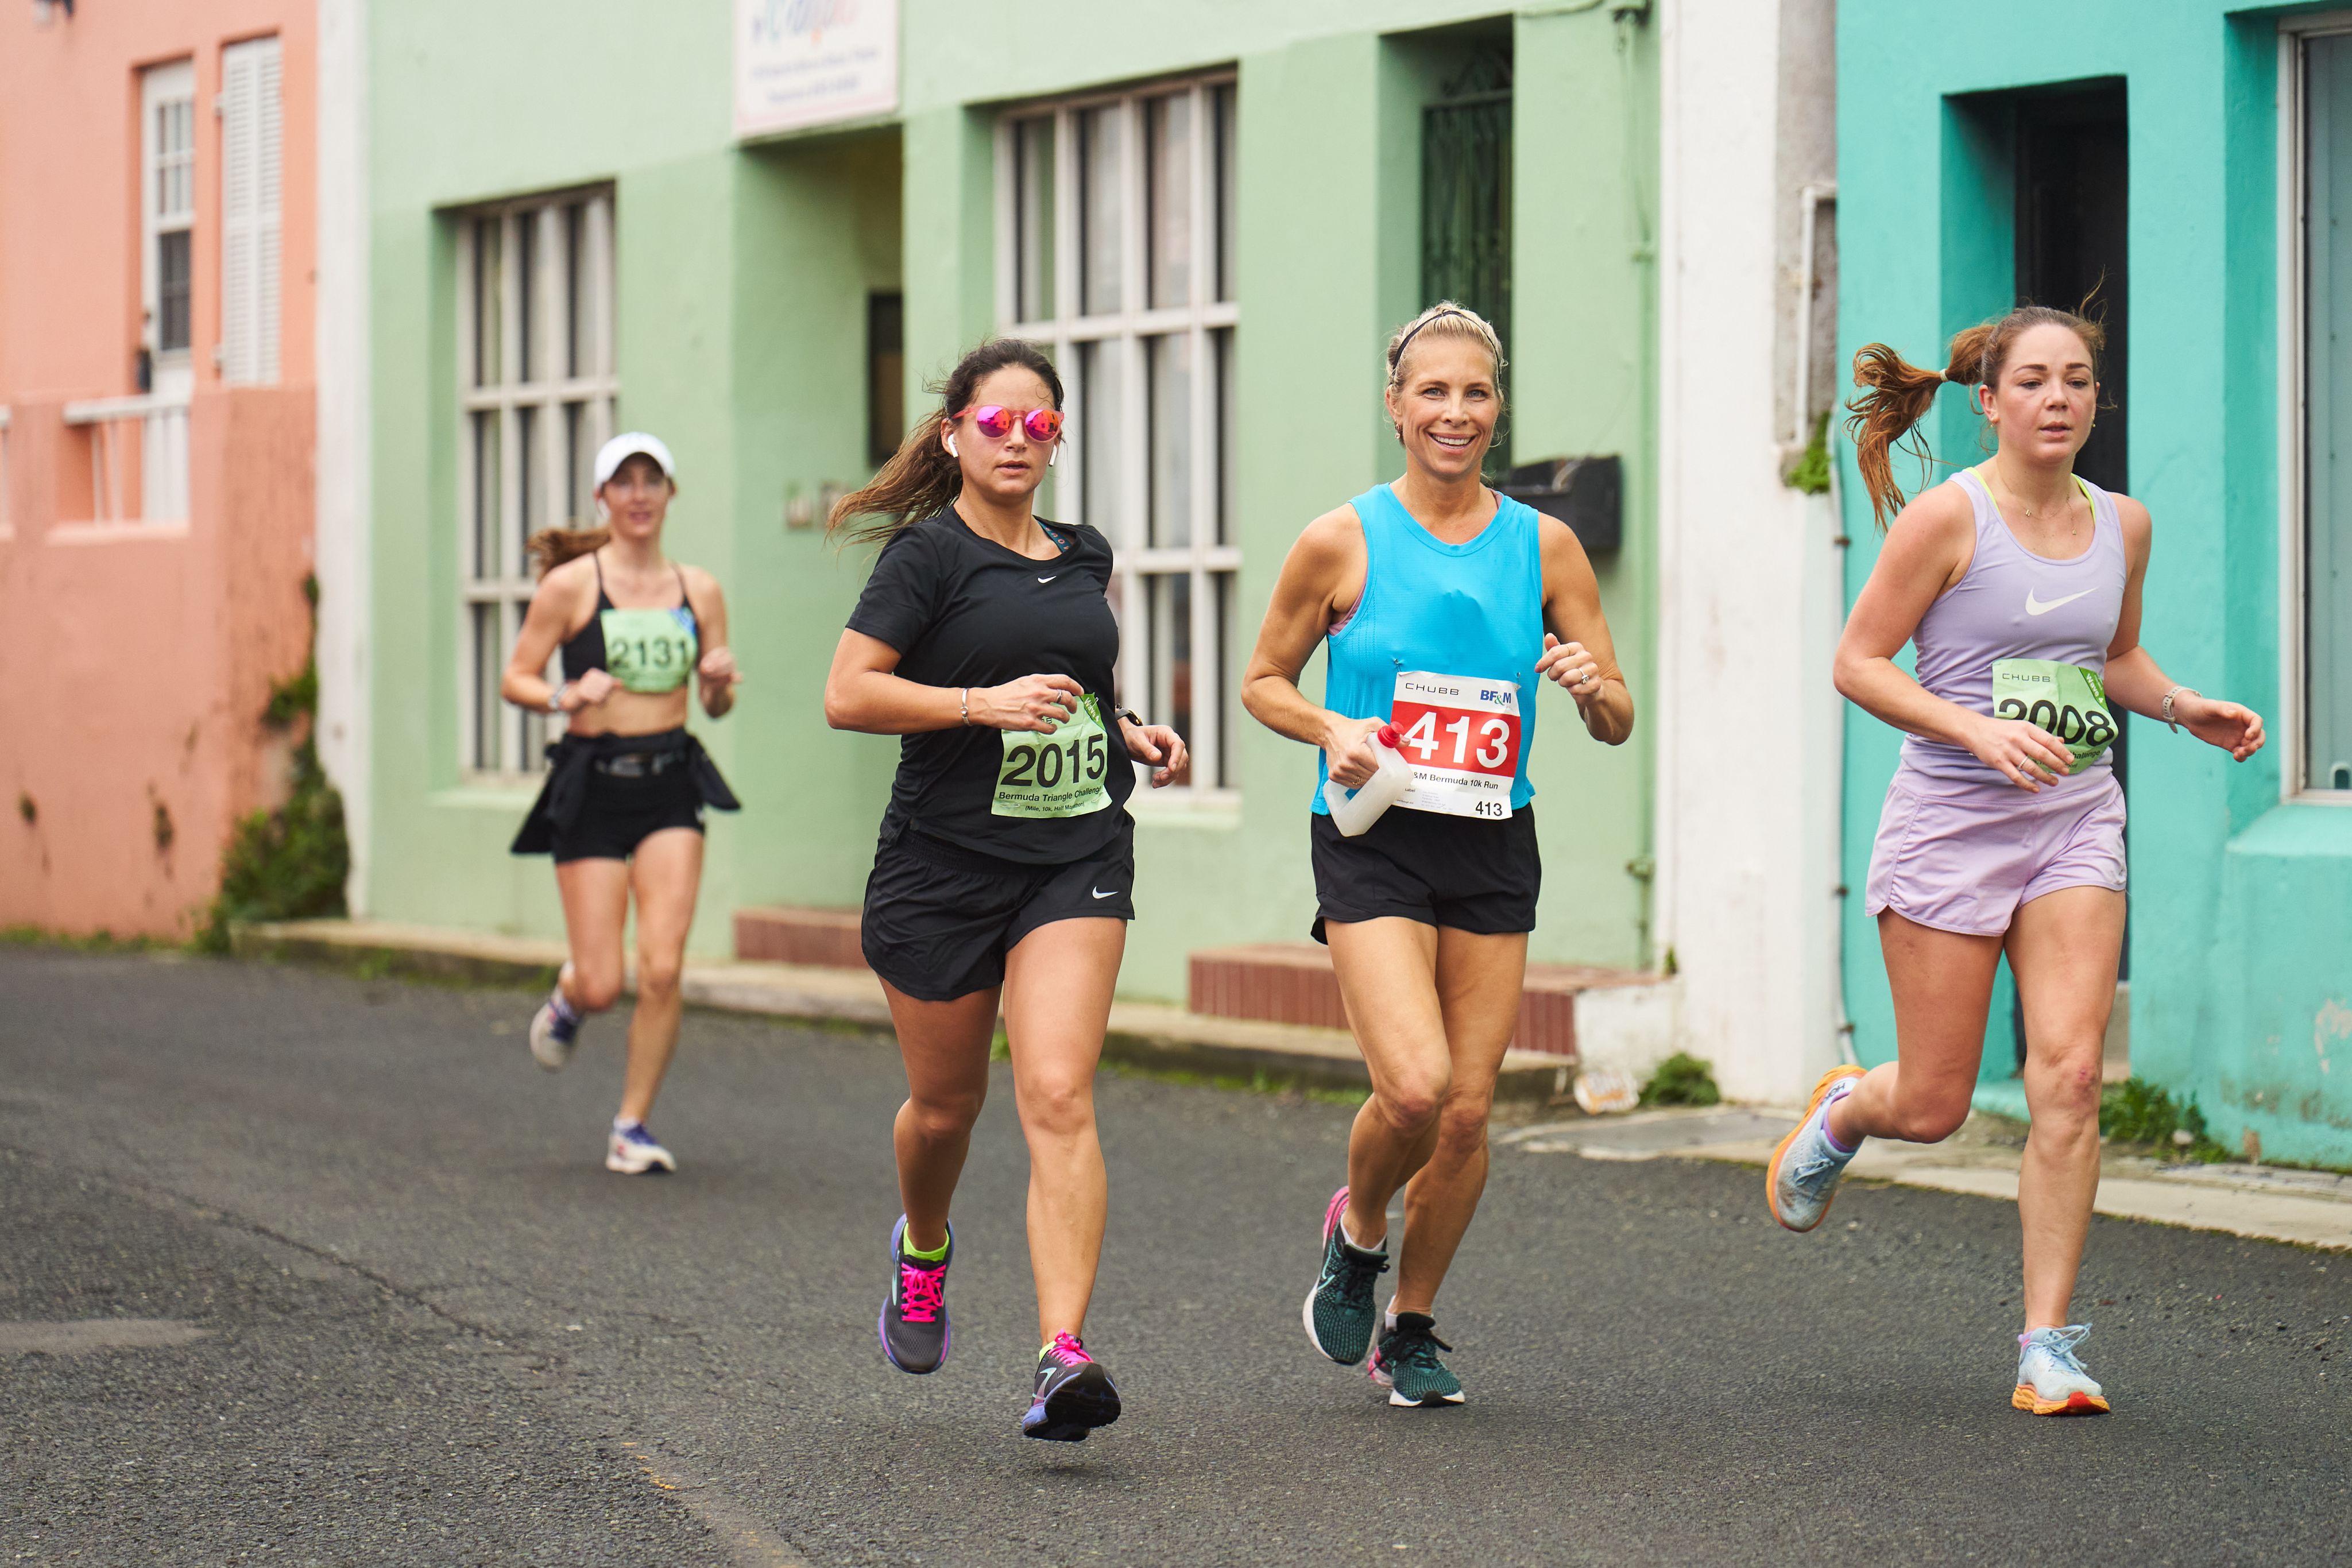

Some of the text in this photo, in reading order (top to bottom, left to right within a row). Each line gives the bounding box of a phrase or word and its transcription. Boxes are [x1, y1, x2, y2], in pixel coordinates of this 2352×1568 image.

[612, 637, 687, 669] 2131
[2002, 673, 2051, 682] CHUBB
[2087, 673, 2099, 697] Wave
[1405, 682, 1459, 695] CHUBB
[1084, 697, 1096, 717] Wave
[1480, 690, 1511, 706] BF&M
[1999, 698, 2114, 746] 2008
[1404, 711, 1510, 768] 413
[1000, 734, 1105, 788] 2015
[2070, 750, 2100, 759] hallenge
[1414, 772, 1499, 790] &M Bermuda 10k Run
[999, 792, 1039, 802] Bermuda
[1042, 792, 1073, 802] Triangle
[1475, 800, 1503, 816] 413
